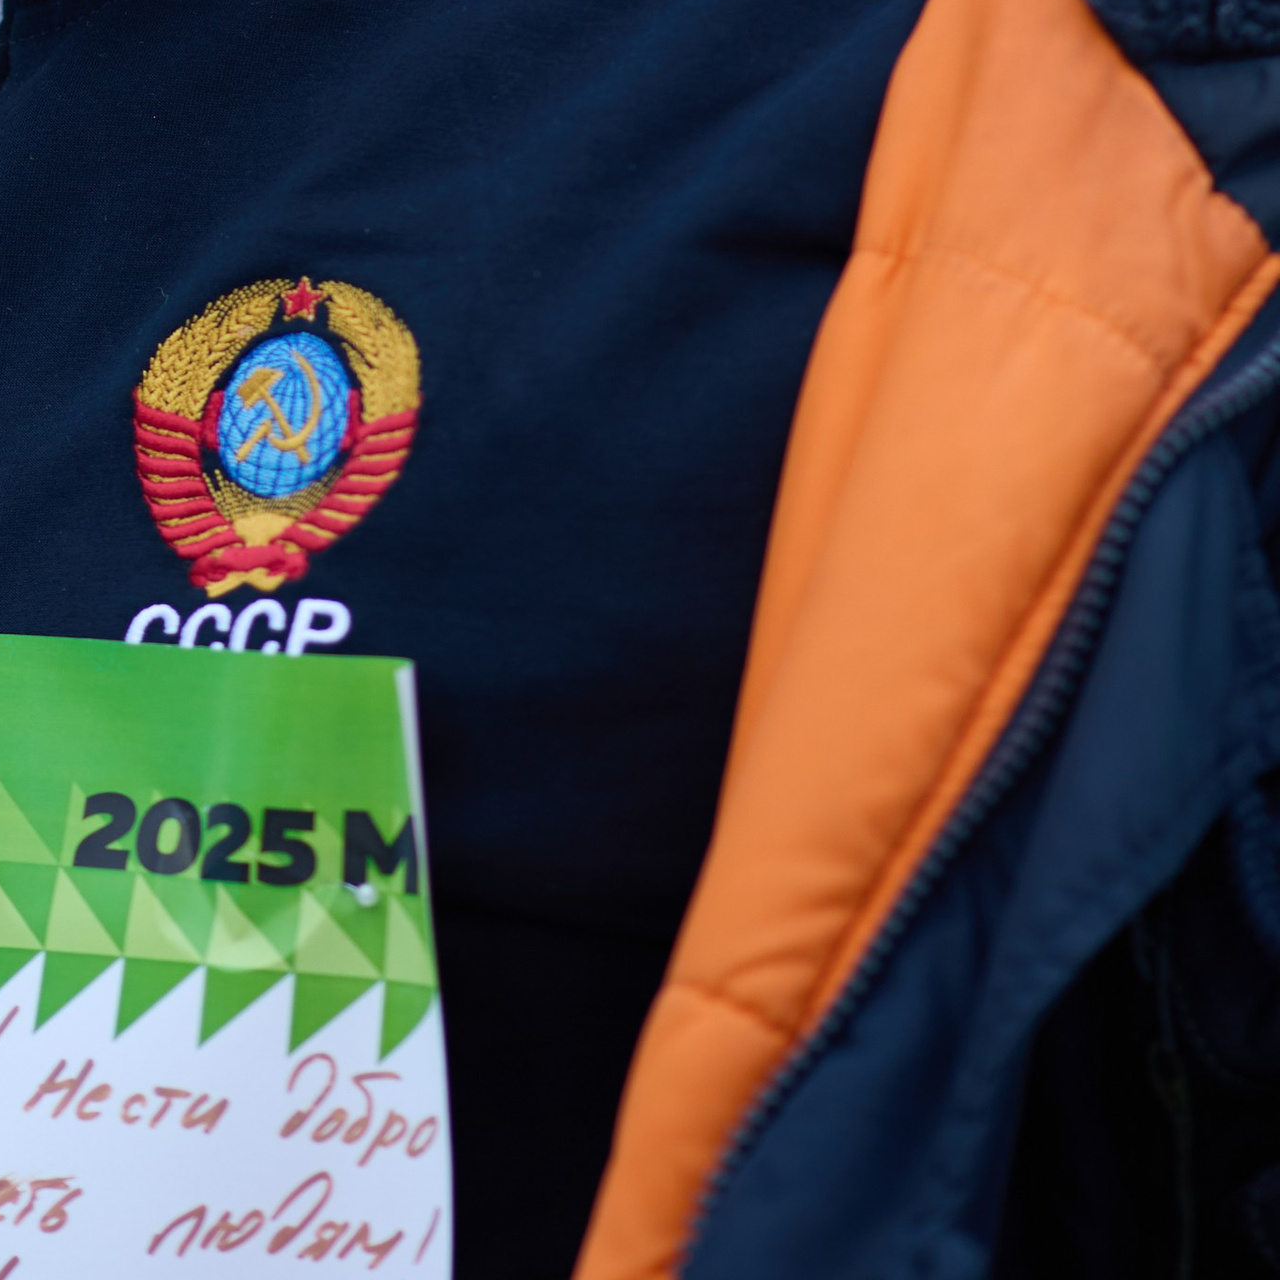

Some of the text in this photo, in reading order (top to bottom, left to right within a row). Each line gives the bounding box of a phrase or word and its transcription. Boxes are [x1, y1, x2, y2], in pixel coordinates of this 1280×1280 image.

[73, 792, 317, 888] 2025
[23, 1058, 229, 1135] Нести
[278, 1052, 439, 1168] добро
